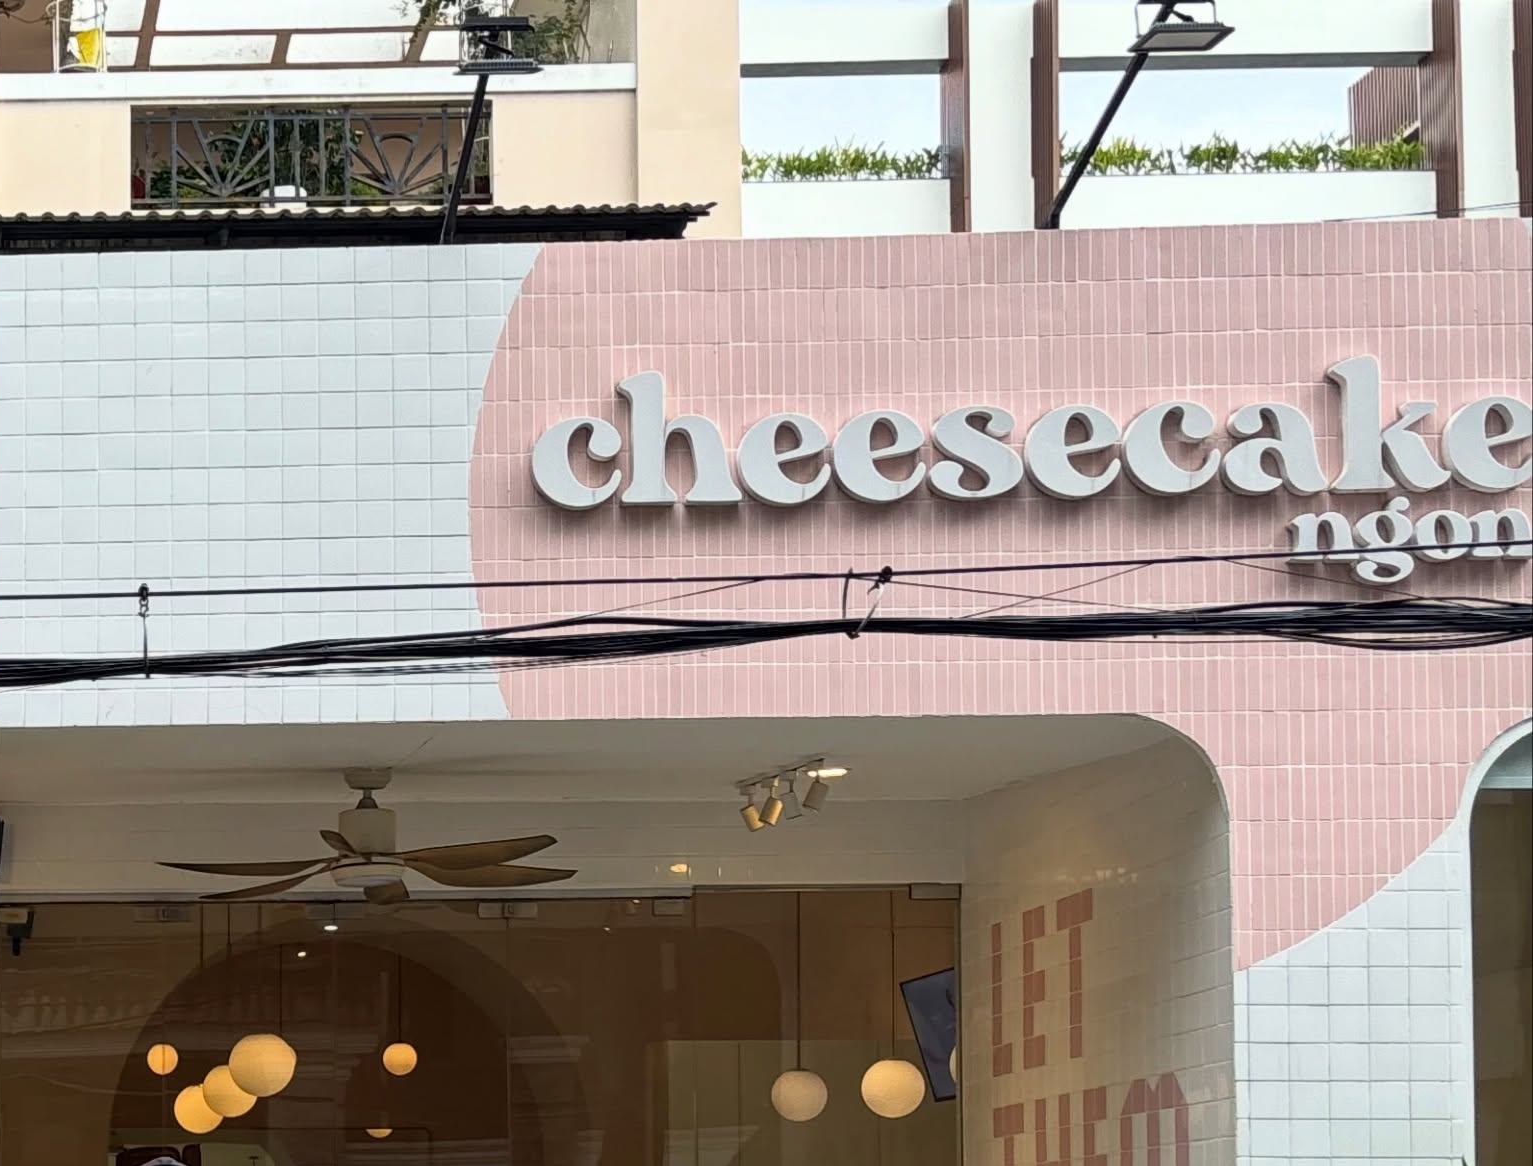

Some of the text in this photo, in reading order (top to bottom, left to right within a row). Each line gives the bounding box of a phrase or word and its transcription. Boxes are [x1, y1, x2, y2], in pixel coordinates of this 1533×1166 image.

[531, 354, 1533, 511] cheesecake
[1285, 496, 1533, 584] ngon
[991, 887, 1093, 1078] LET
